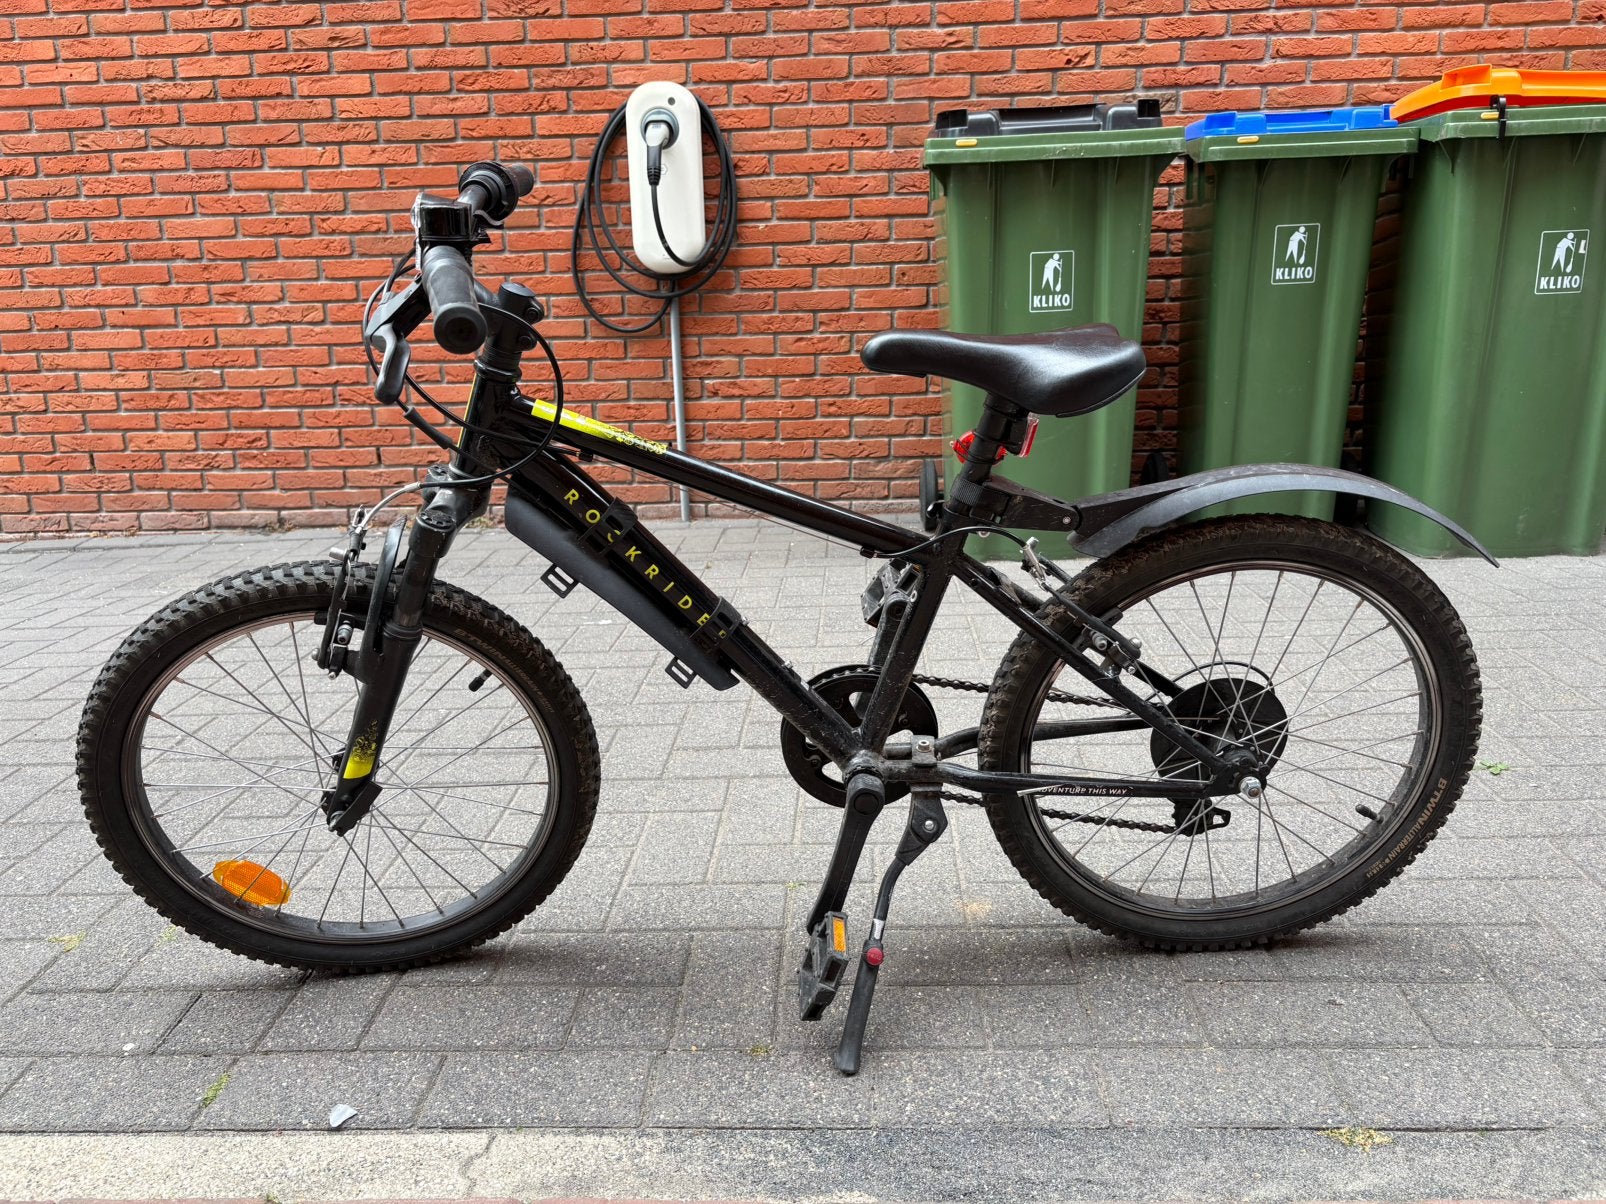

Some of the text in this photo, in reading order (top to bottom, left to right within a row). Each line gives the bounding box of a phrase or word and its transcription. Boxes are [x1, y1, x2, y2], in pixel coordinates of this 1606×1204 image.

[1275, 266, 1313, 280] KLIKO
[1539, 275, 1580, 289] KLIKO
[1033, 293, 1070, 308] KLIKO
